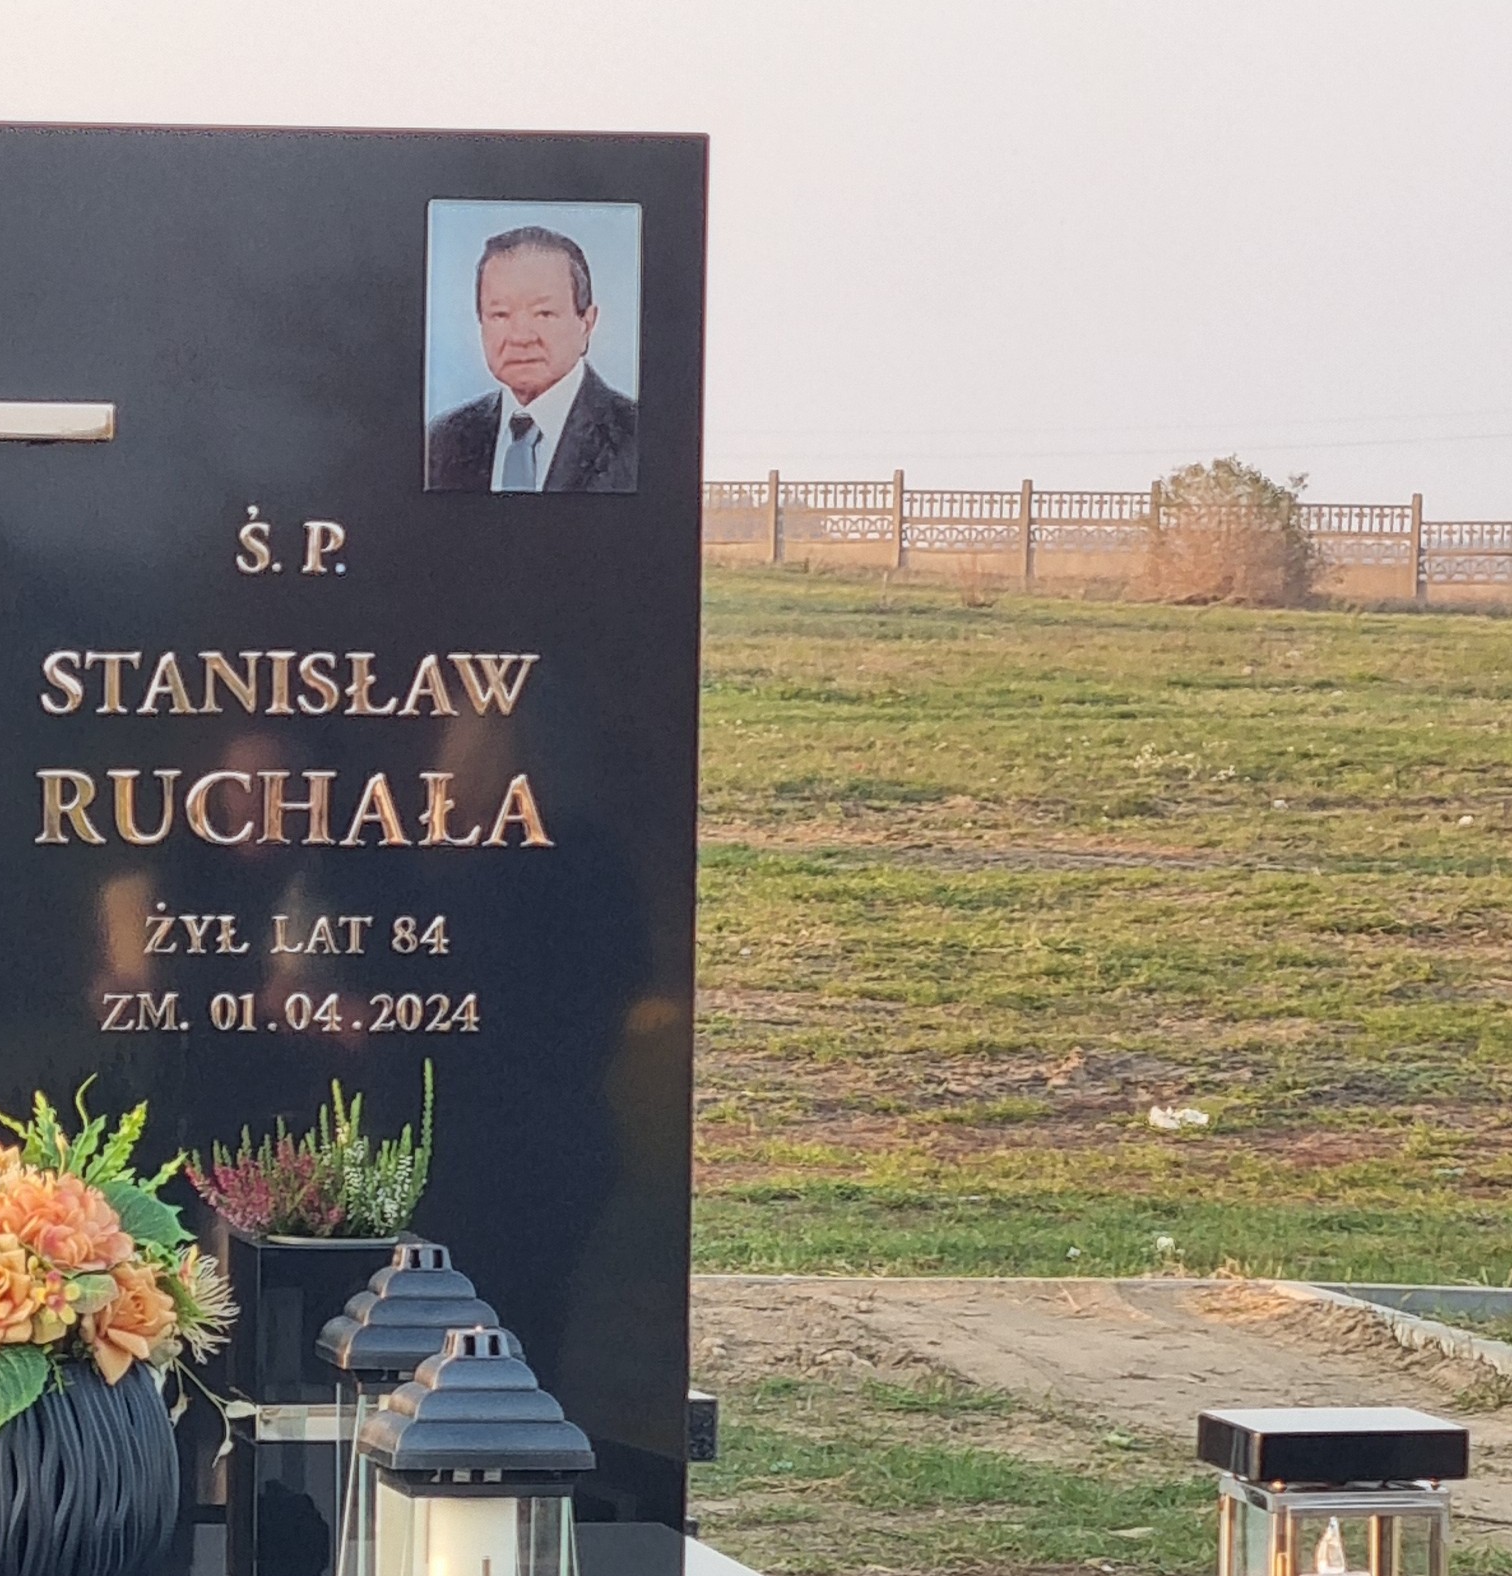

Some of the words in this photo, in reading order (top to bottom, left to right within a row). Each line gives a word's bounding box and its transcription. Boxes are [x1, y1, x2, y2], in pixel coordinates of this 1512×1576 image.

[302, 520, 346, 575] P.
[40, 650, 540, 717] STANISŁAW
[34, 769, 555, 846] RUCHAŁA
[144, 903, 250, 954] ŻYŁ
[271, 916, 373, 954] LAT
[392, 915, 450, 954] 84
[101, 994, 189, 1031] ZM.
